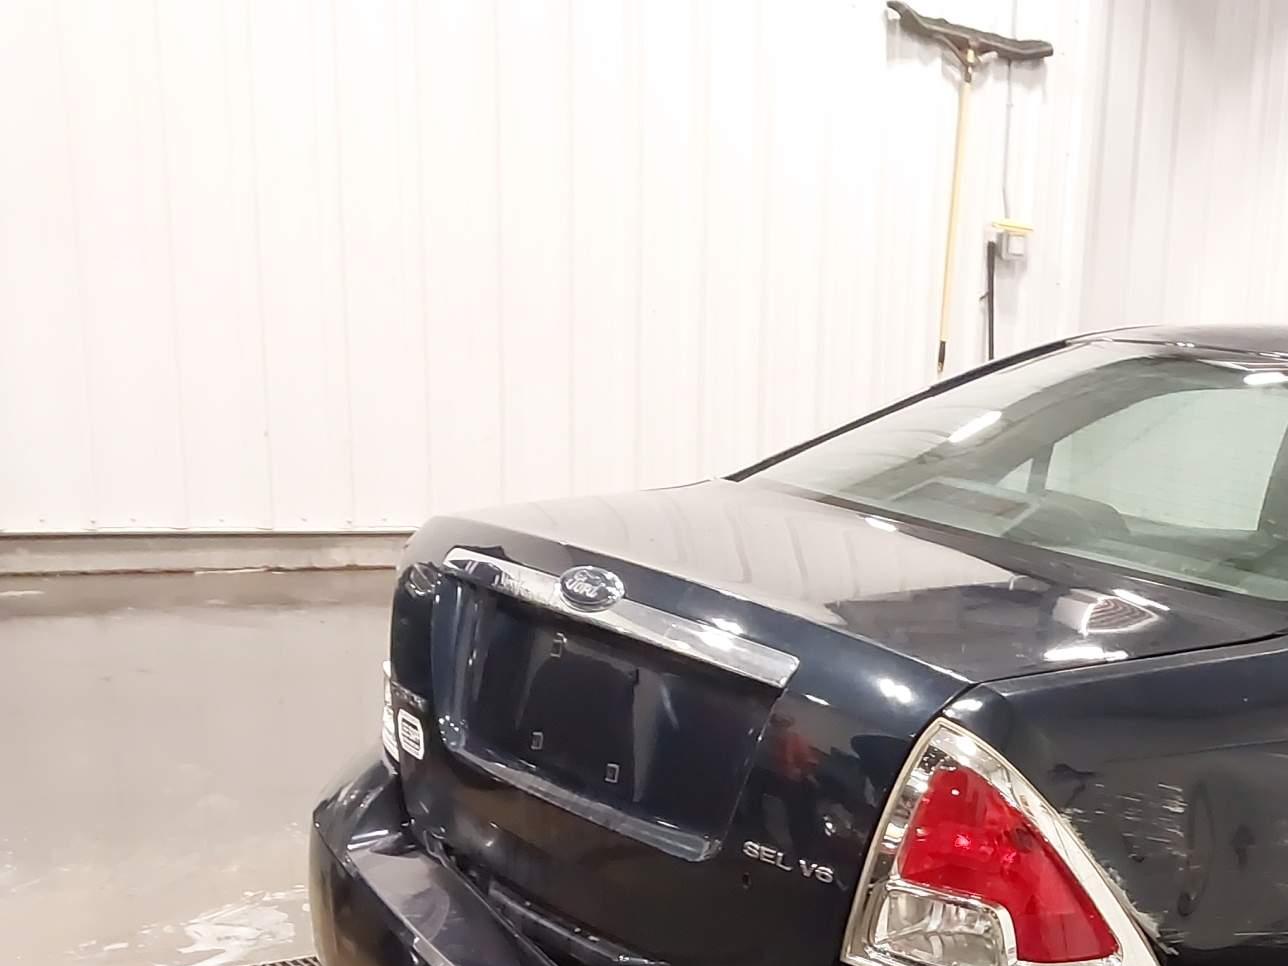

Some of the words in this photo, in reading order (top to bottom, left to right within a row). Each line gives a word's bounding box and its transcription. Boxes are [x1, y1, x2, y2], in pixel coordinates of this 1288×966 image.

[564, 569, 606, 599] Ford
[742, 840, 794, 872] SEL
[799, 859, 835, 884] V6
